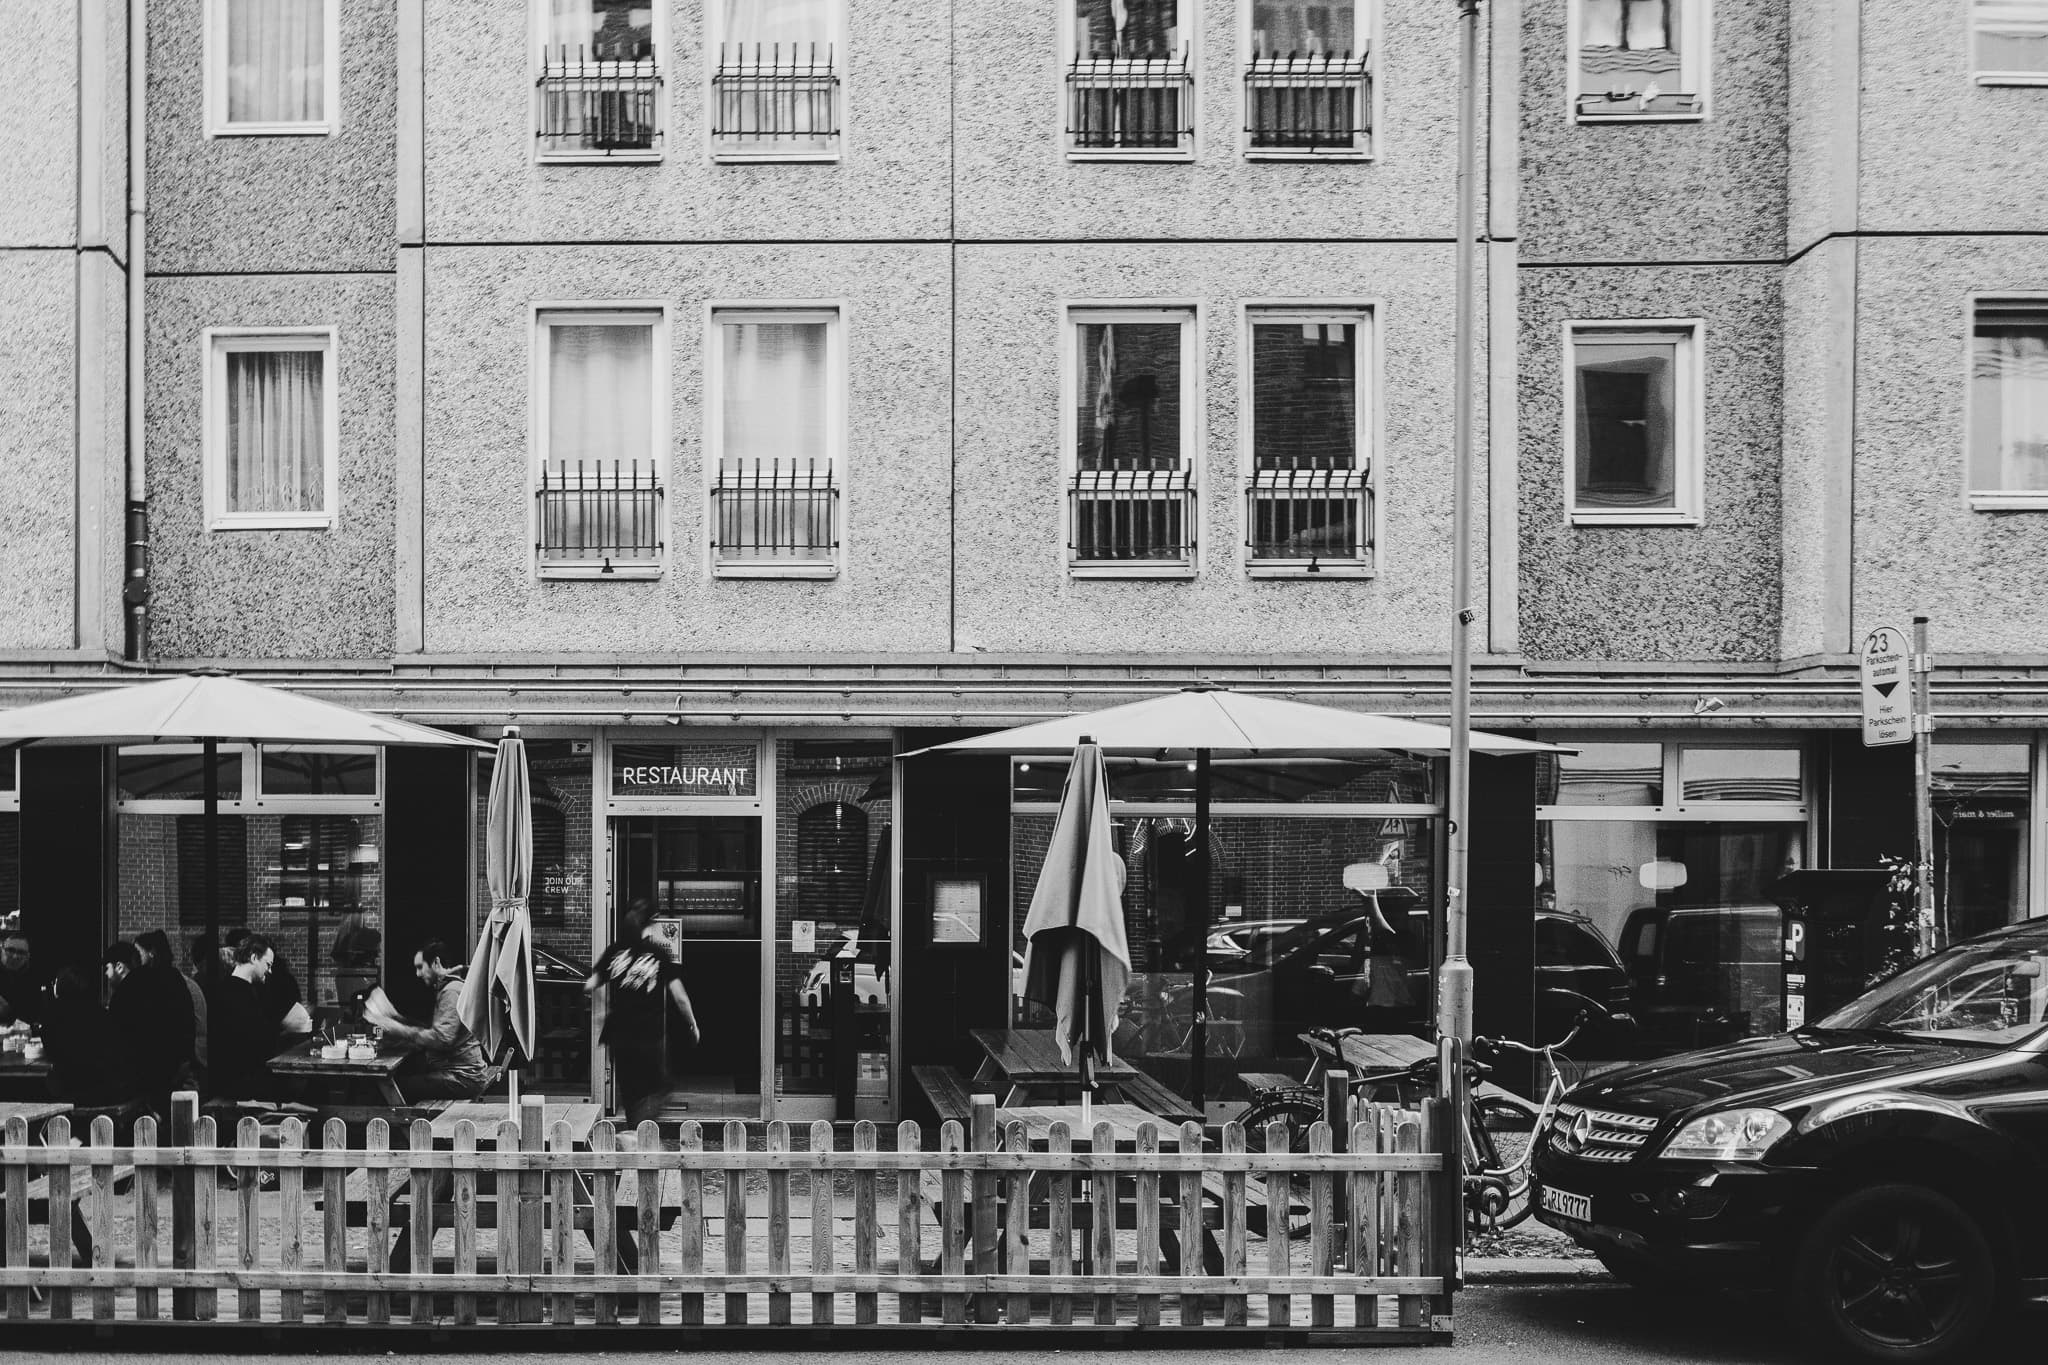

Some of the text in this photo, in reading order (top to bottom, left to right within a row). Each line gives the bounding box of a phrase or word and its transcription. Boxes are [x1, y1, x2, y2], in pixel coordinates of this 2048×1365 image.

[1869, 633, 1888, 654] 23
[1880, 705, 1893, 714] Hier
[1869, 716, 1906, 727] Parkschein
[623, 766, 748, 786] RESTAURANT
[544, 877, 564, 885] JOIN
[545, 886, 569, 894] CREW
[1791, 923, 1804, 954] P
